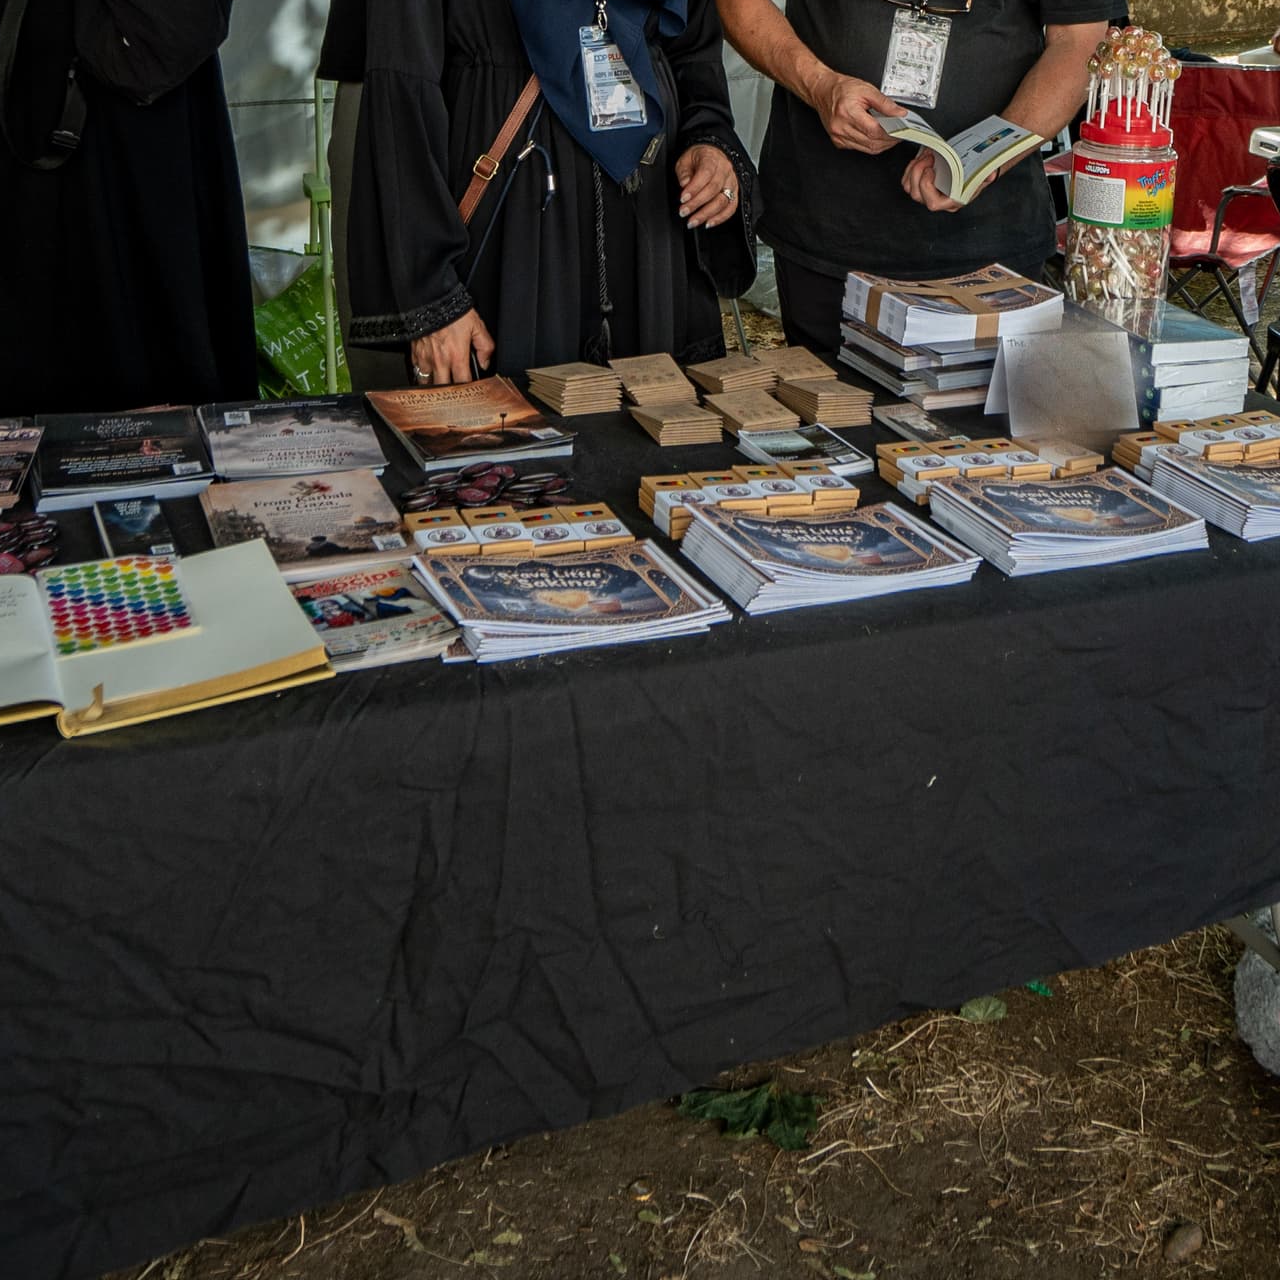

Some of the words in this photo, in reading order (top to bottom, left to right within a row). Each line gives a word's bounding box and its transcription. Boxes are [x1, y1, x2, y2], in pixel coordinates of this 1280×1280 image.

[296, 491, 353, 503] Karbala
[552, 568, 603, 579] Little
[519, 577, 598, 589] Sakina
